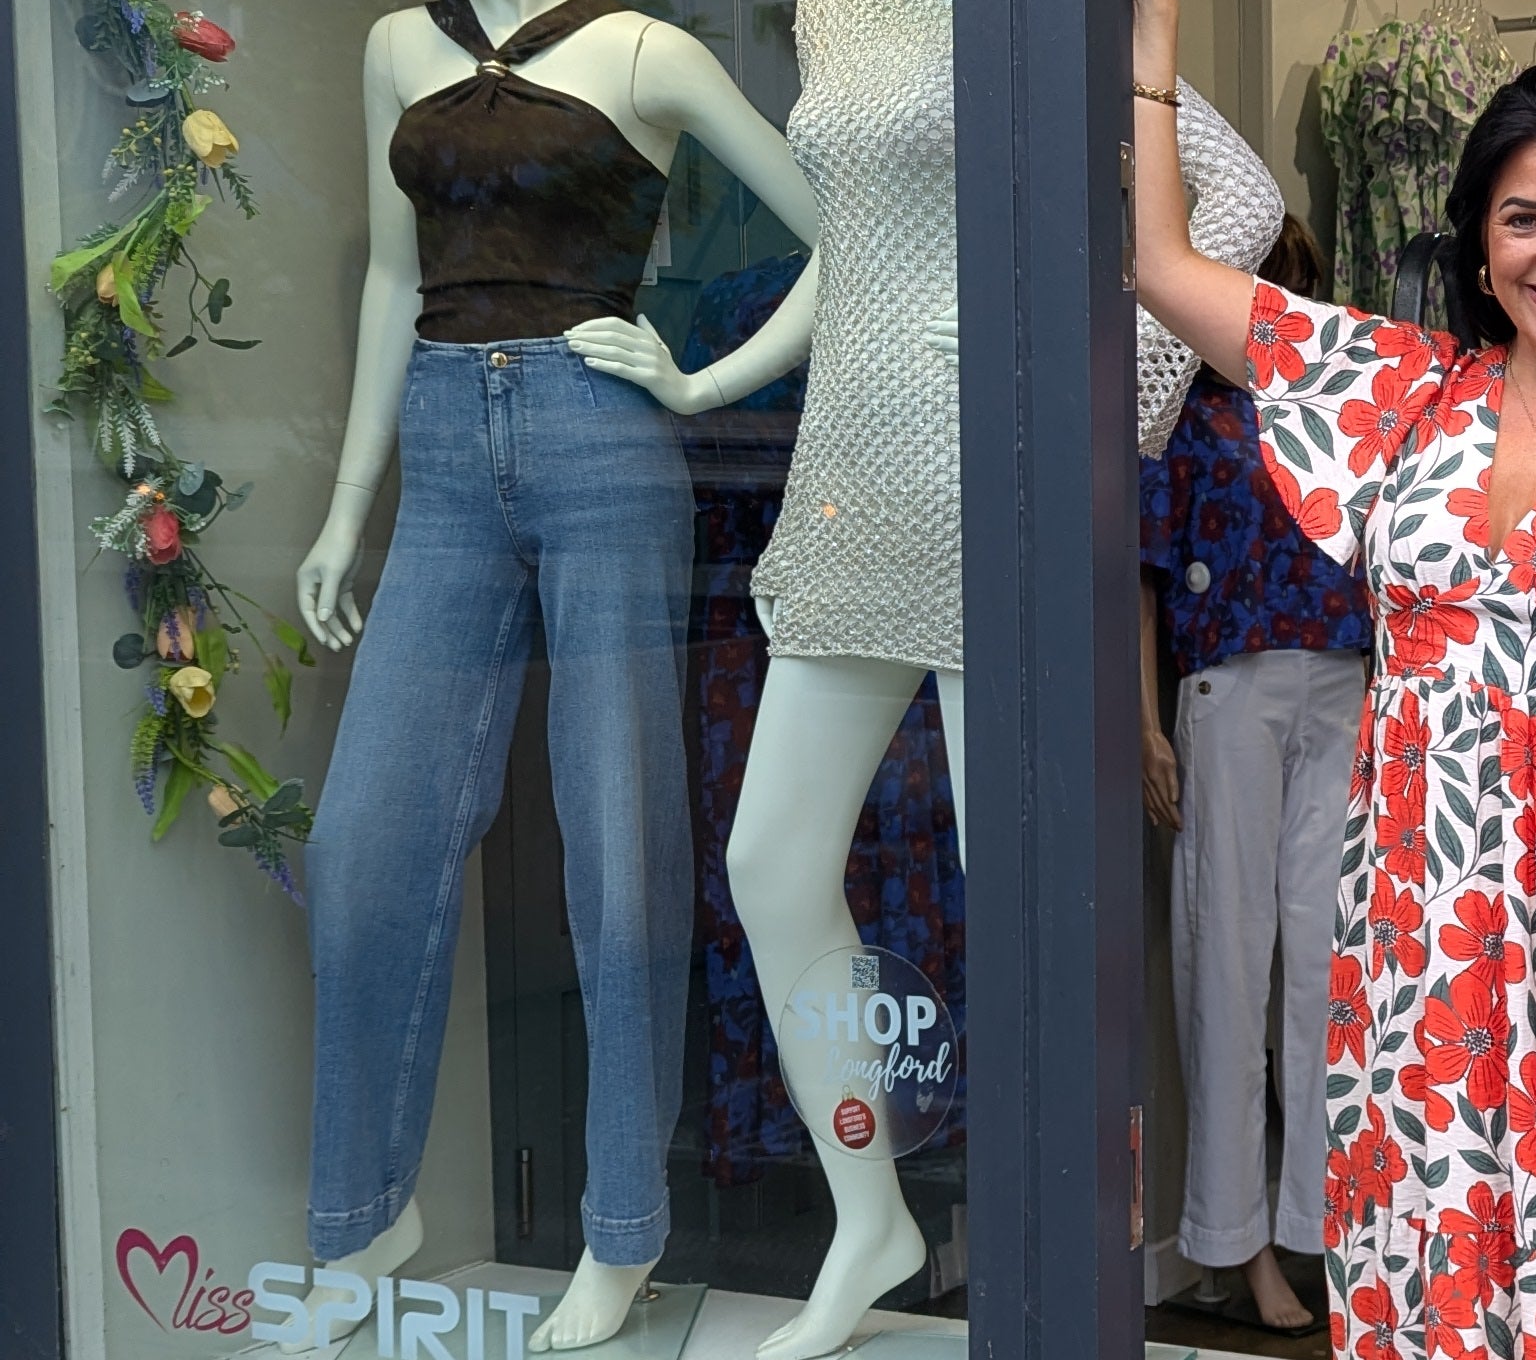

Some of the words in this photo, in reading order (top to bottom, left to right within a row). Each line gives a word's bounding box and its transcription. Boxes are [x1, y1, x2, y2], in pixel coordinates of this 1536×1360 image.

[793, 990, 937, 1047] SHOP
[823, 1041, 953, 1101] Longford
[115, 1227, 256, 1336] Miss
